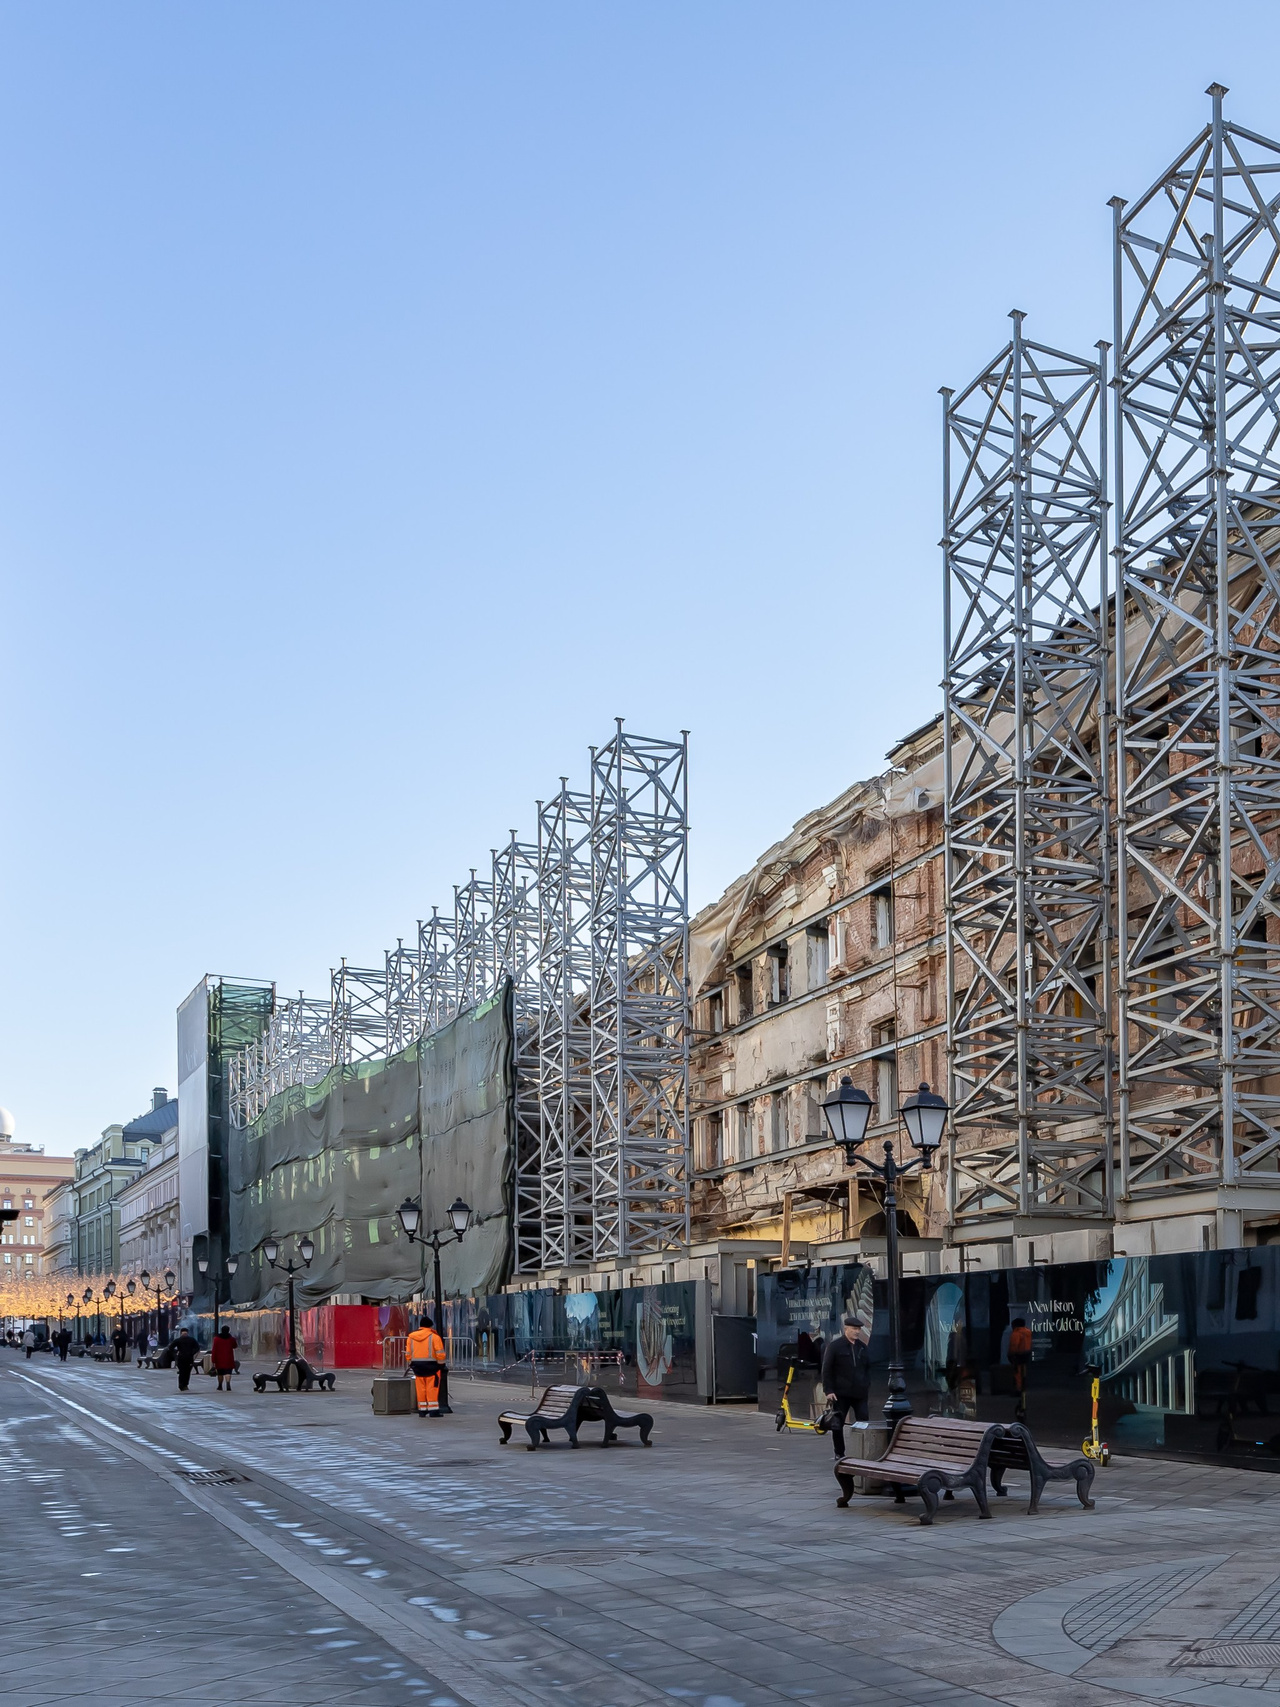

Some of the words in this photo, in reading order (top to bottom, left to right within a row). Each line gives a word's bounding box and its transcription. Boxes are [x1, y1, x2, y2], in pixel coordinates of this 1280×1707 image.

[1034, 1300, 1049, 1313] New
[1031, 1318, 1042, 1332] for
[1043, 1318, 1055, 1332] the
[1056, 1317, 1068, 1332] Old
[1069, 1318, 1084, 1334] City
